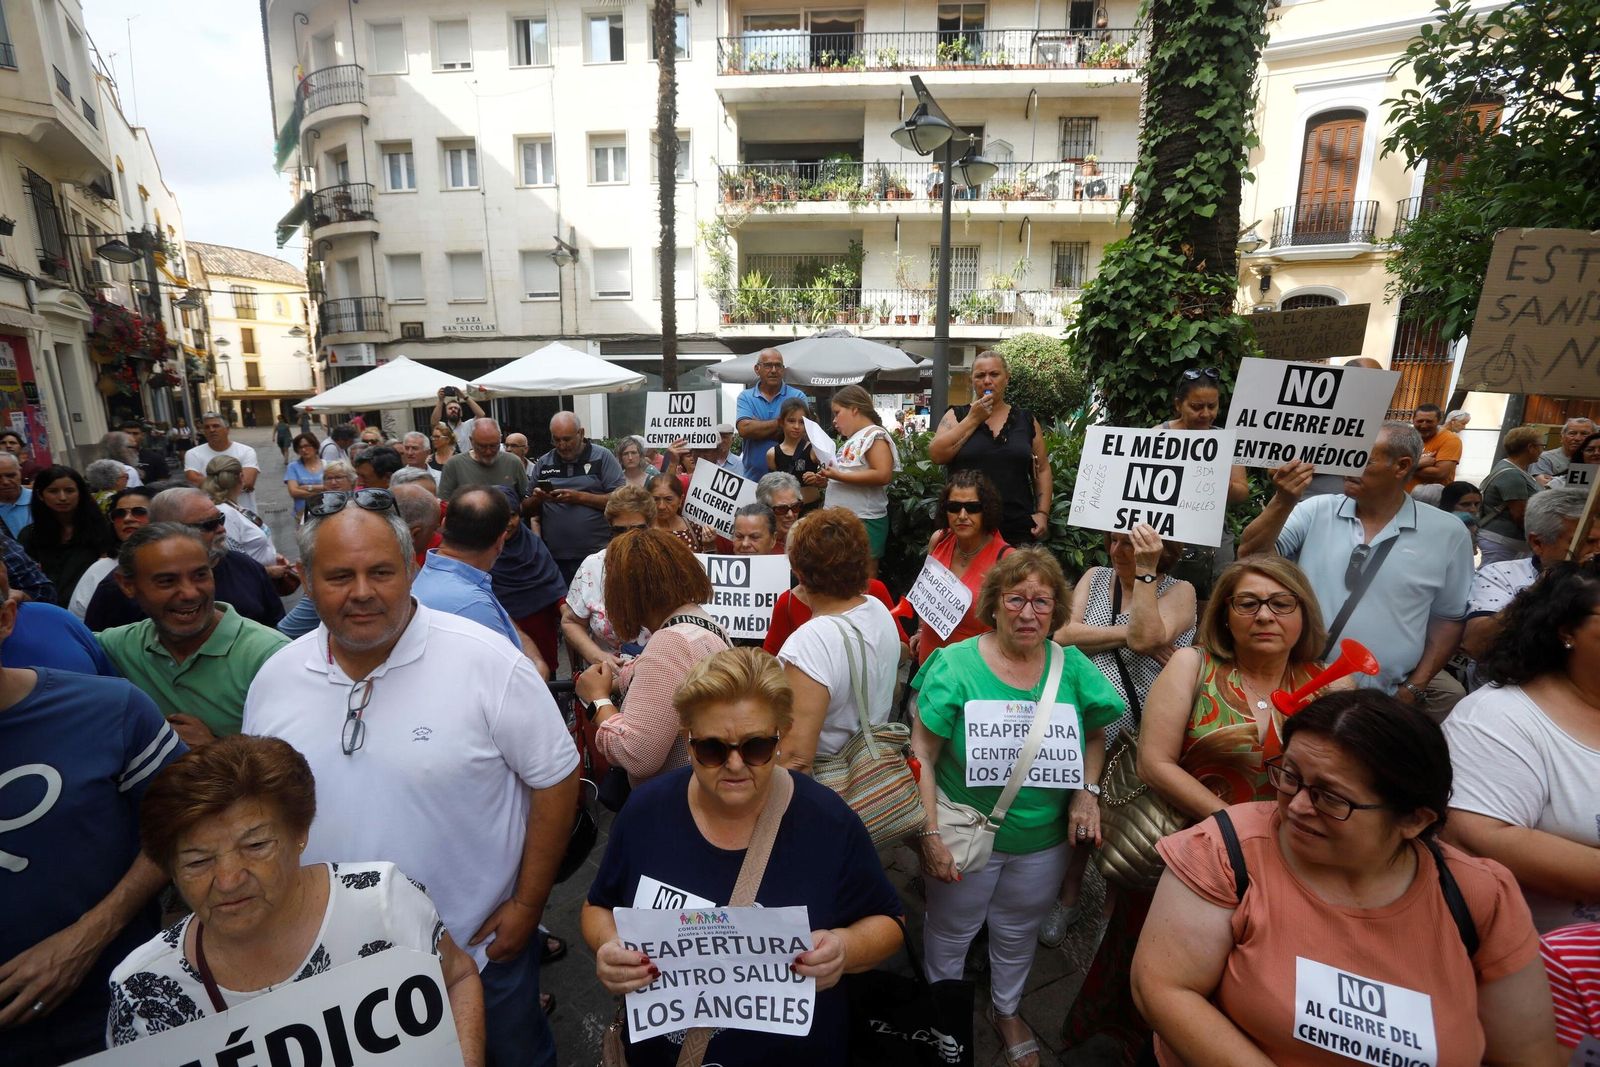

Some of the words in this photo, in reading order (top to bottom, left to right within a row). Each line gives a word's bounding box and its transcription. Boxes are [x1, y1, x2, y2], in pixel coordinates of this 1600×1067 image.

[1505, 244, 1600, 284] EST
[1543, 336, 1600, 380] N
[810, 376, 839, 385] CERVEZAS
[1283, 369, 1336, 406] NO
[670, 394, 694, 413] NO
[650, 417, 661, 427] AL
[664, 417, 695, 427] CIERRE
[697, 417, 712, 427] DEL
[1236, 408, 1258, 428] AL
[1263, 410, 1331, 434] CIERRE
[1331, 416, 1365, 438] DEL
[682, 431, 717, 444] MÉDICO
[1101, 433, 1125, 456] EL
[1130, 432, 1218, 462] MÉDICO
[1233, 439, 1296, 463] ENTRO
[1299, 443, 1368, 469] MÉDICO
[712, 471, 740, 497] NO
[1127, 466, 1177, 501] NO
[1194, 481, 1216, 495] LOS
[1568, 471, 1589, 484] EL
[691, 487, 702, 500] AL
[702, 492, 735, 515] CIERRE
[1178, 499, 1216, 511] ANGELES
[684, 502, 714, 525] CENTRO
[713, 517, 736, 536] MÉD
[1113, 508, 1141, 531] SE
[1147, 510, 1175, 537] VA
[711, 559, 747, 585] NO
[709, 591, 751, 607] ERRE
[921, 567, 967, 614] REAPERTURA
[733, 614, 770, 632] MÉDI
[918, 601, 952, 637] ÁNGELES
[935, 601, 958, 625] SALUD
[968, 722, 1078, 740] REAPERURA
[1034, 747, 1078, 761] ALUD
[969, 767, 999, 781] LOS
[1002, 763, 1081, 784] ÁGELES
[655, 887, 683, 910] NO
[1341, 976, 1382, 1013] NO
[180, 974, 445, 1067] ÉDICO
[633, 999, 685, 1032] LOS
[693, 991, 810, 1026] ÁNGELES
[1305, 1000, 1324, 1020] AL
[1328, 1007, 1387, 1039] CIERRE
[1390, 1025, 1423, 1050] DEL
[1298, 1023, 1362, 1056] CENTRO
